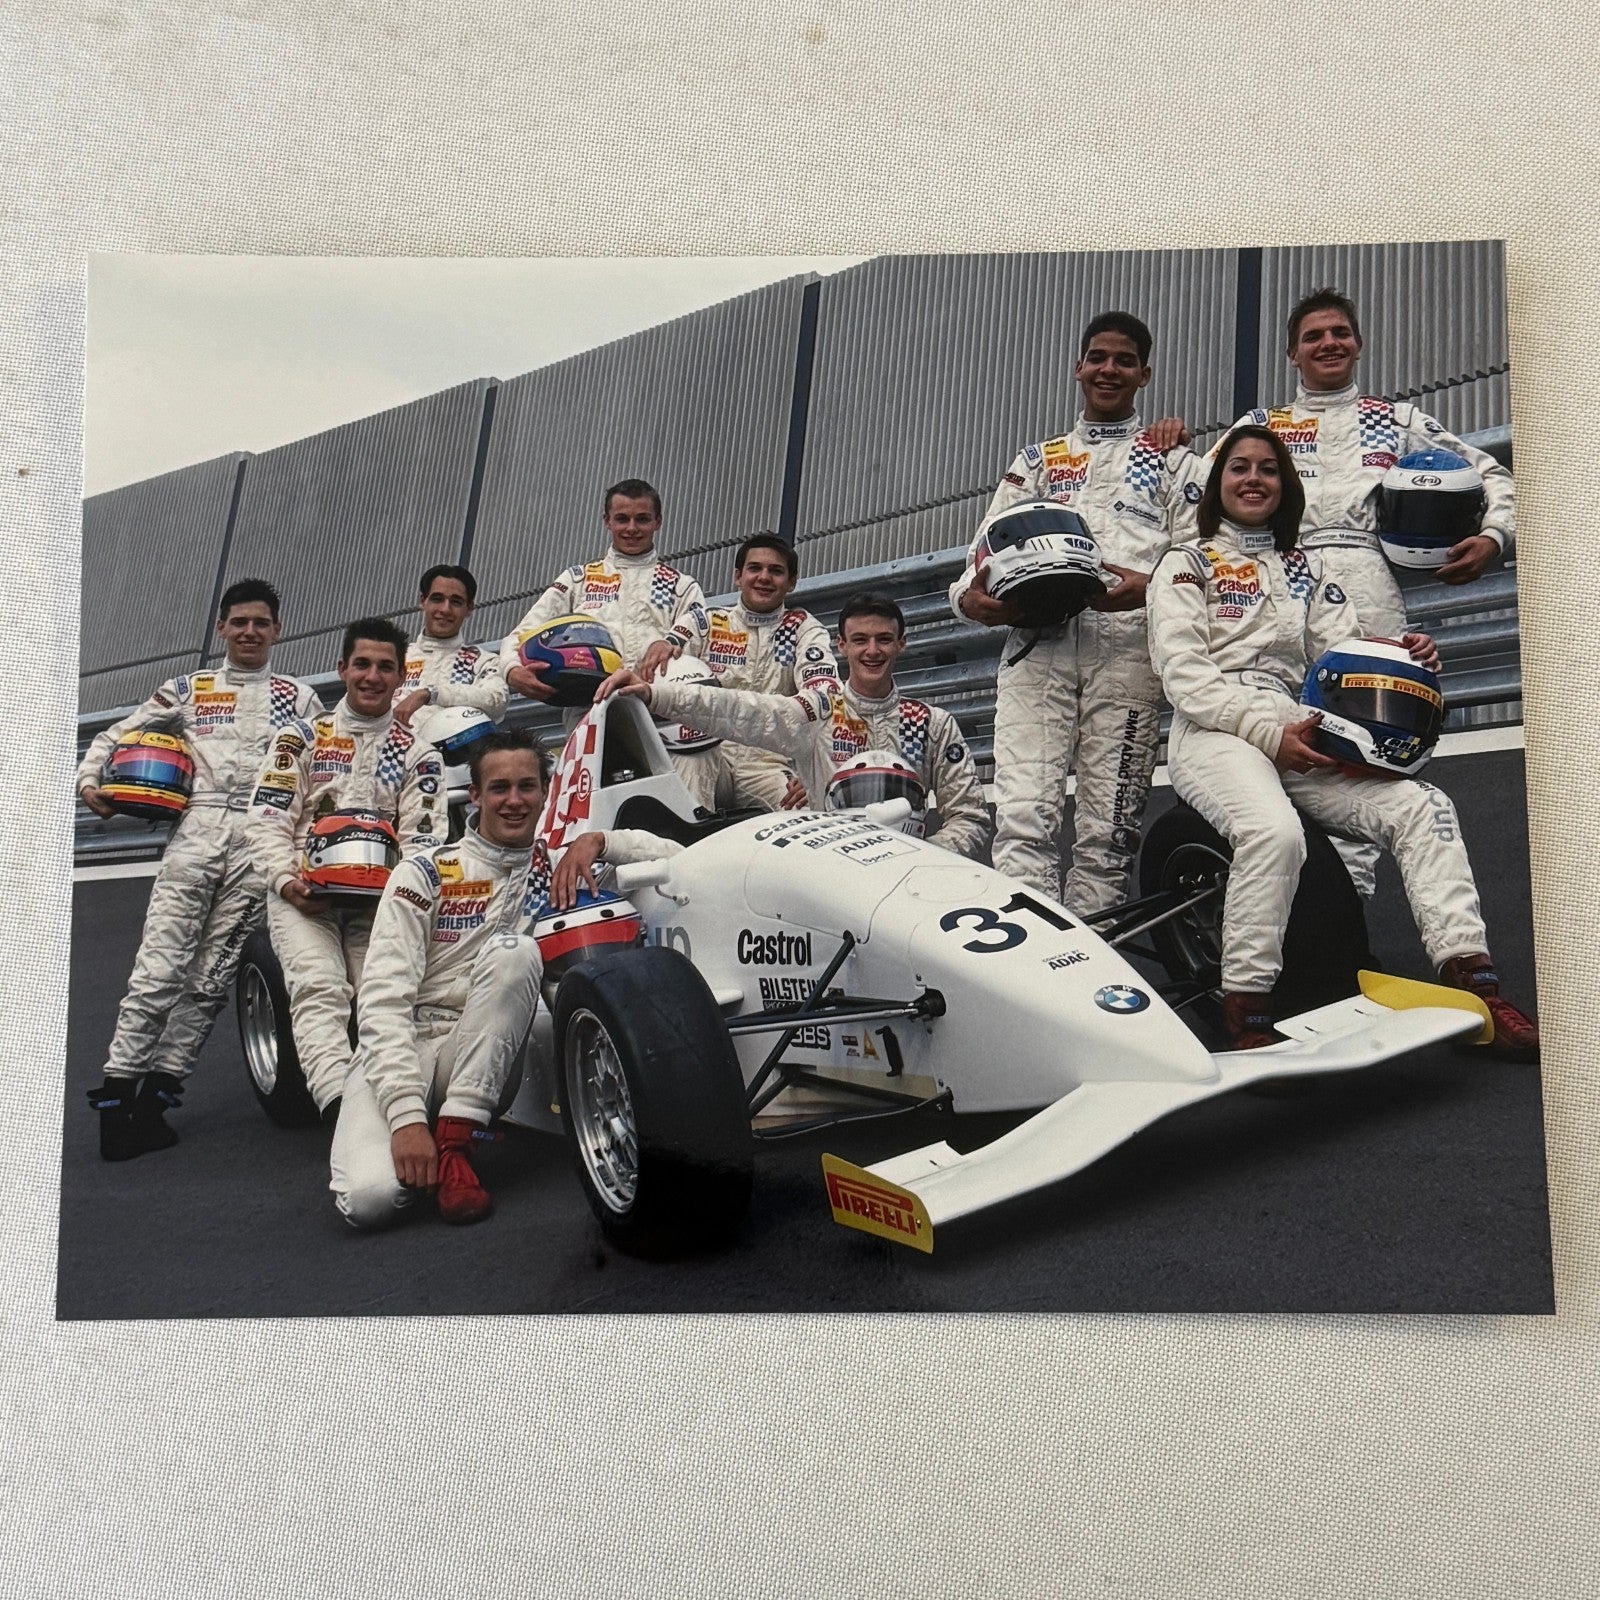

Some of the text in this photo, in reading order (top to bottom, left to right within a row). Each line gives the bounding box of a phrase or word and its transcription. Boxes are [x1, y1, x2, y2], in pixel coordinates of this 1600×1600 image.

[1100, 426, 1127, 435] Basler
[1286, 443, 1317, 454] STEIN
[709, 641, 747, 656] Castrol
[709, 653, 747, 665] BILSTEIN
[804, 666, 834, 679] Castrol
[195, 704, 236, 716] Castrol
[195, 716, 235, 727] BILSTEIN
[1124, 709, 1140, 743] BMW
[313, 749, 355, 764] Castrol
[1116, 743, 1134, 780] ADAC
[313, 761, 353, 774] BILSTEIN
[841, 834, 893, 854] ADAC
[862, 851, 894, 866] Sport
[438, 897, 491, 917] Castrol
[437, 913, 486, 931] BILSTEIN
[939, 892, 1077, 954] 31
[737, 928, 812, 966] Castrol
[1048, 952, 1090, 971] ADAC
[827, 1171, 917, 1237] PIRELLI
